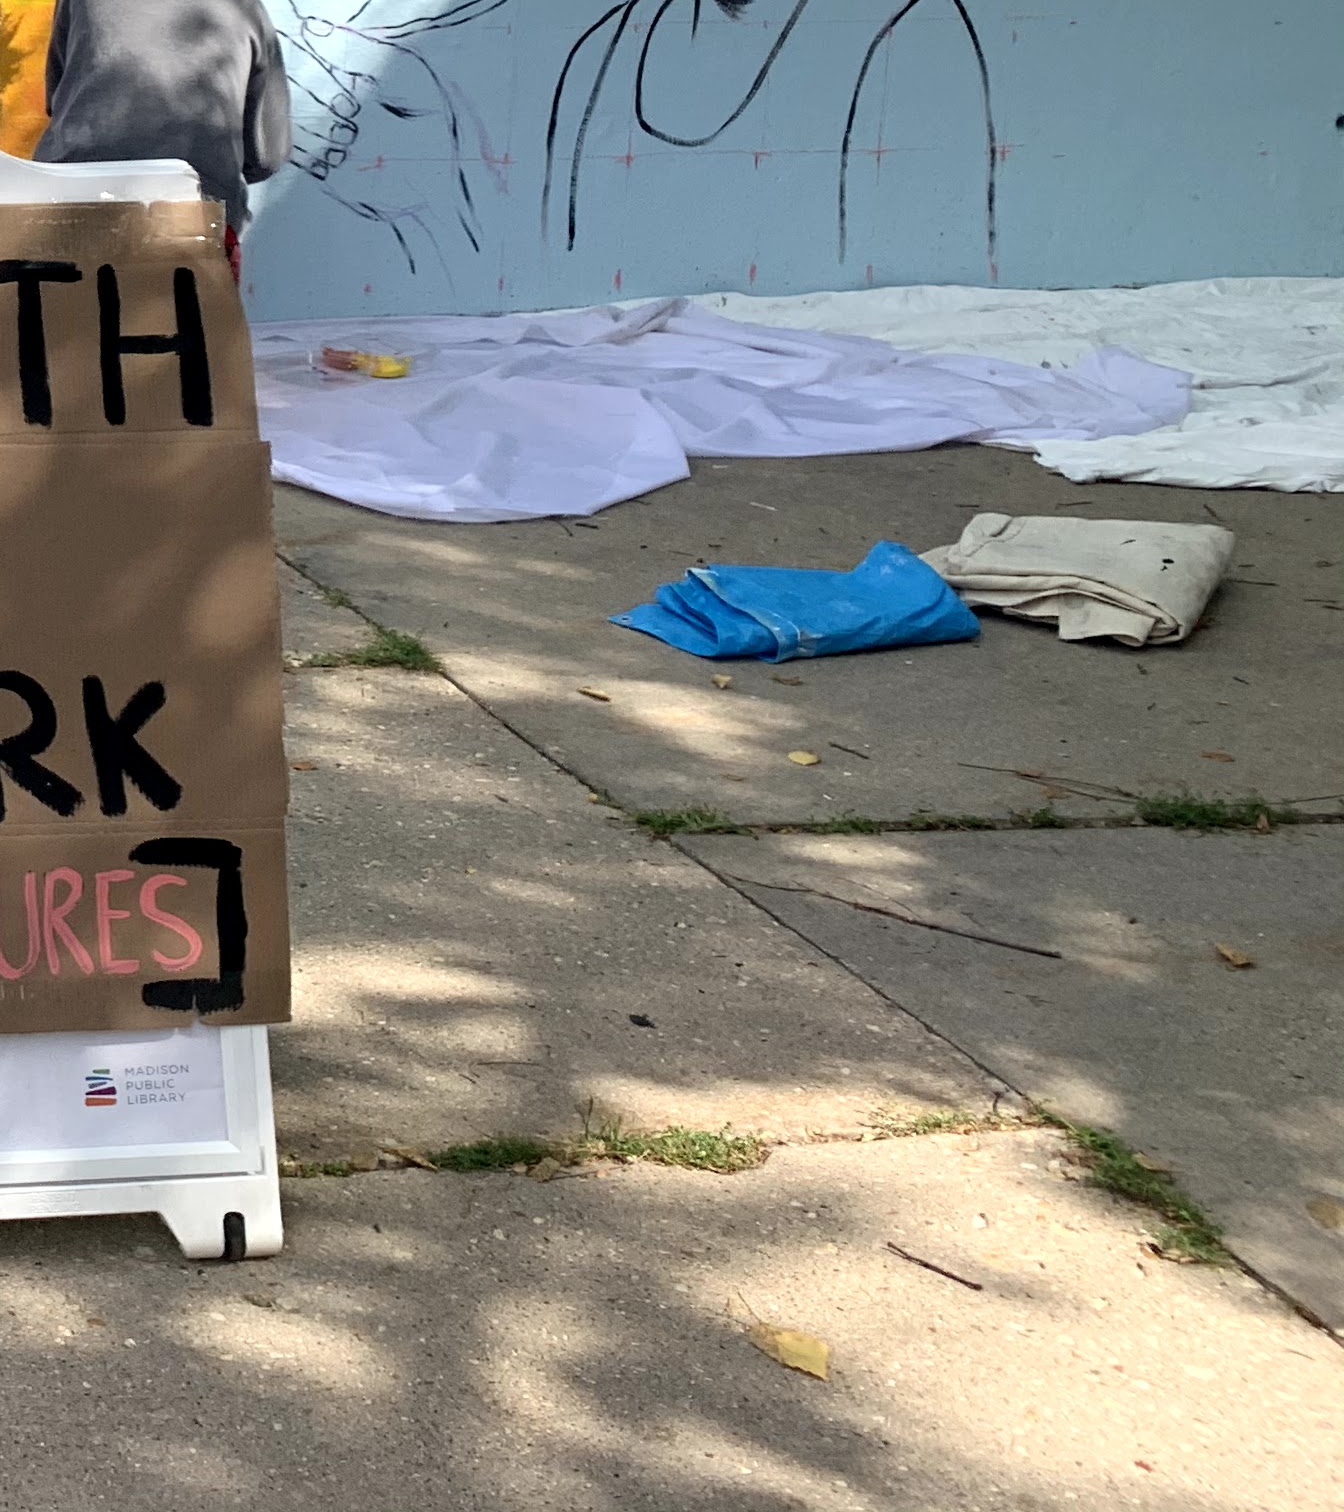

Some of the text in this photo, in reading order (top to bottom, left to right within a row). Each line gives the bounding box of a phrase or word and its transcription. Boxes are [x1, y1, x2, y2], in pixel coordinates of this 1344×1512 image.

[125, 1064, 190, 1076] MADISON
[126, 1079, 175, 1091] PUBLIC
[127, 1092, 186, 1105] LIBRARY
